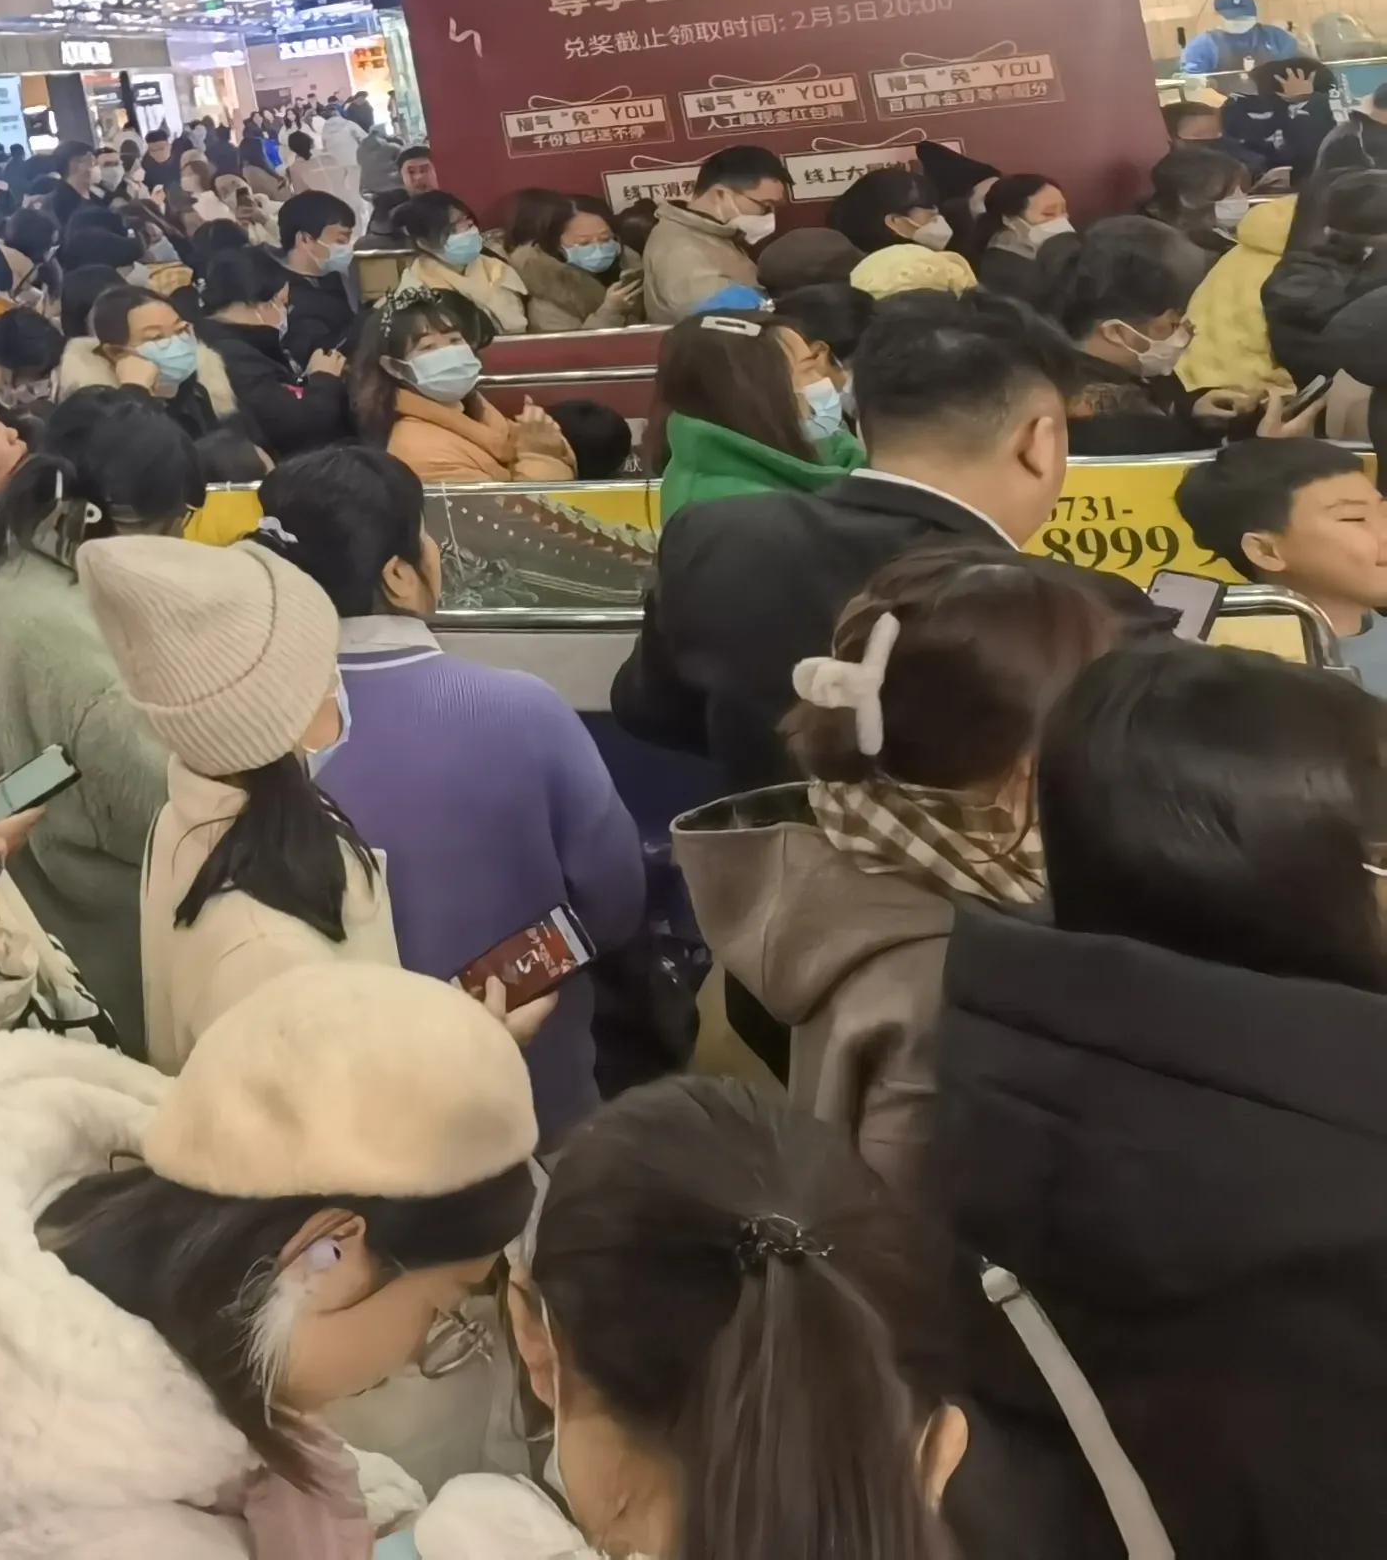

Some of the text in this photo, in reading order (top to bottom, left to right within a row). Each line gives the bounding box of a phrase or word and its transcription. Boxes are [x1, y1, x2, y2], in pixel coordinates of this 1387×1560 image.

[993, 60, 1041, 79] YOU
[796, 82, 845, 99] YOU
[610, 103, 654, 121] YOU
[1047, 496, 1133, 522] 731-
[1042, 525, 1217, 569] 8999
